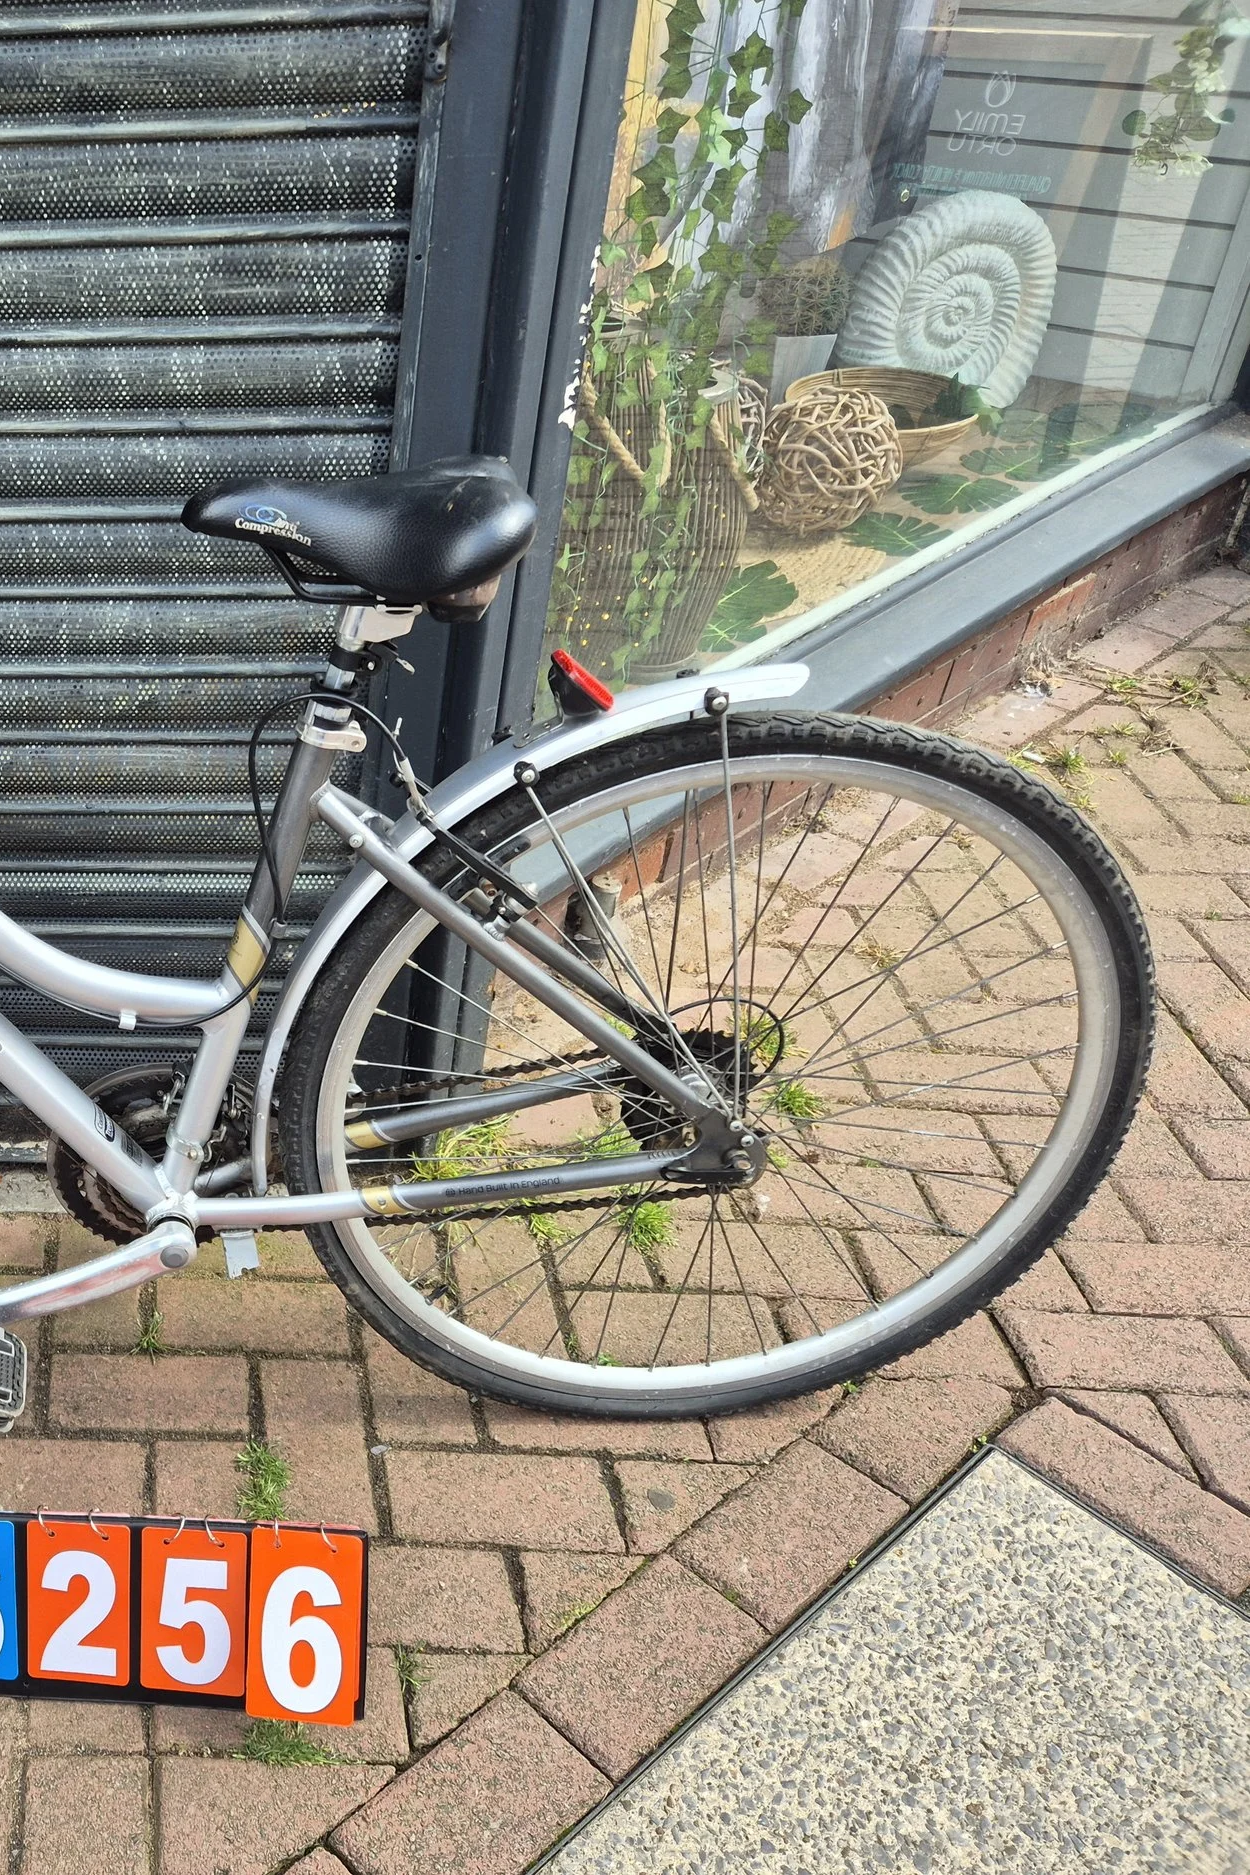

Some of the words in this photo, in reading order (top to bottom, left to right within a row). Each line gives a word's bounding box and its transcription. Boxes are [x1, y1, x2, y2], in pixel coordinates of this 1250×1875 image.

[235, 517, 312, 547] Compression
[458, 1186, 484, 1196] Hand
[486, 1183, 508, 1193] Built
[521, 1176, 561, 1189] England
